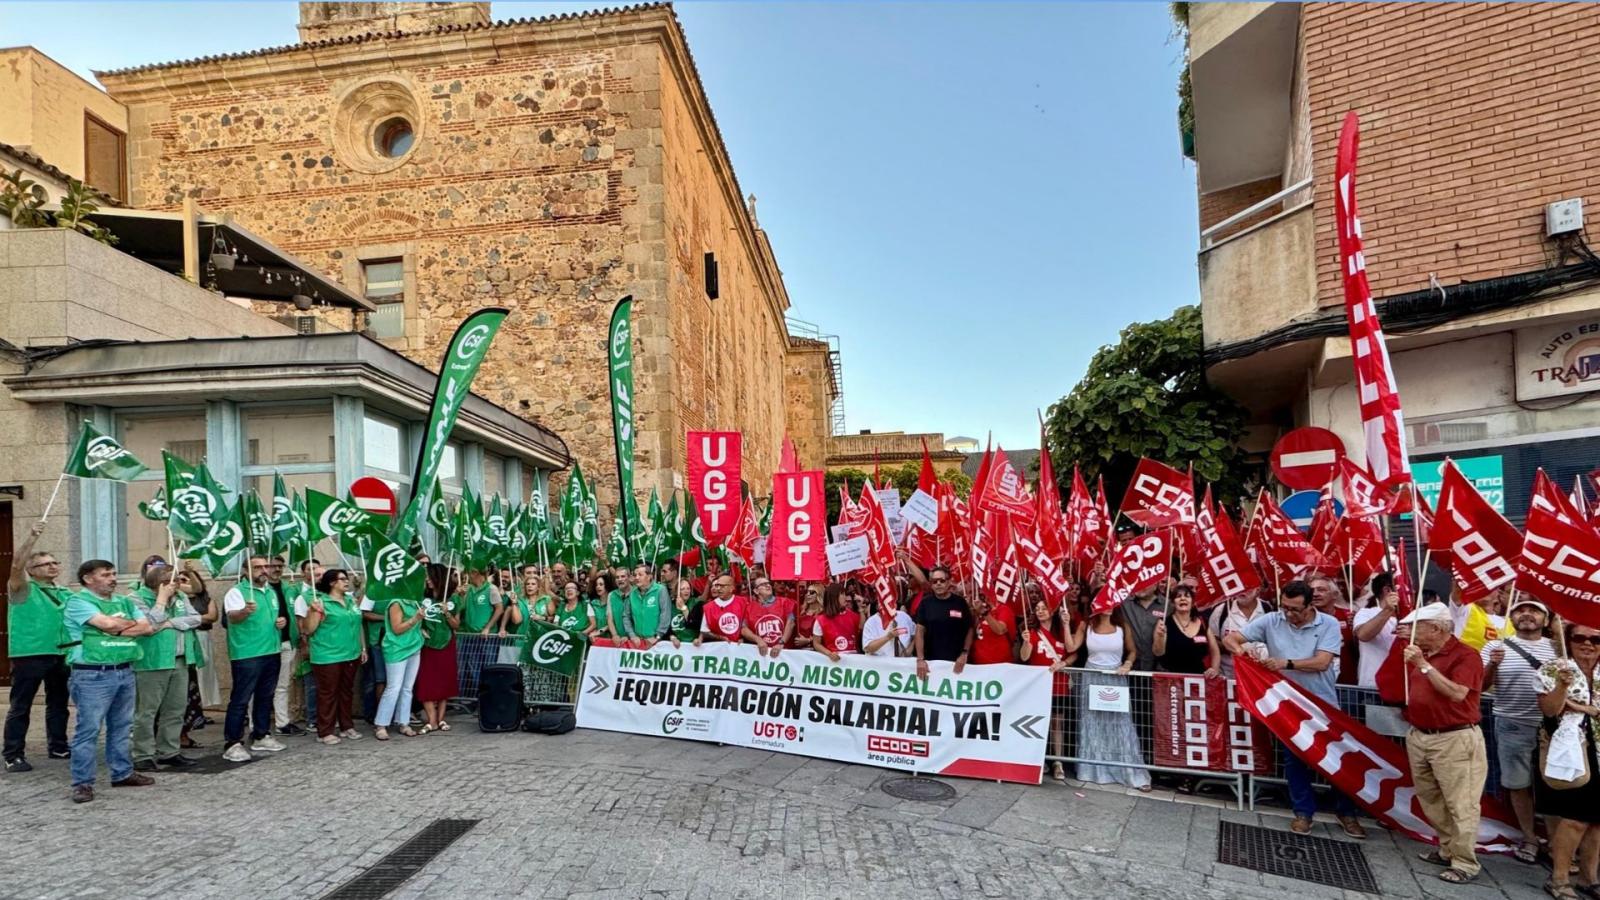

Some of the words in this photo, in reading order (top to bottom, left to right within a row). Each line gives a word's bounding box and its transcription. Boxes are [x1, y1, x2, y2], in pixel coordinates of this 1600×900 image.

[1541, 331, 1573, 359] AUTO
[702, 436, 727, 532] UGT
[786, 476, 811, 576] UGT
[1521, 529, 1600, 584] CC
[721, 615, 737, 626] UGT
[758, 619, 781, 636] UGT
[541, 638, 573, 658] CSIF
[619, 651, 684, 672] MISMO
[692, 655, 794, 685] TRABAJO,
[801, 664, 880, 690] MISMO
[887, 671, 1003, 701] SALARIO
[613, 677, 803, 720] ¡EQUIPARACIÓN
[808, 695, 942, 737] SALARIAL
[952, 711, 1002, 741] YA!
[666, 716, 684, 726] CSIF
[1170, 685, 1180, 756] extremadura
[754, 721, 785, 740] UGT
[1184, 677, 1209, 767] CCOO
[752, 738, 785, 749] Extremadura
[869, 737, 911, 753] CCOO
[867, 752, 885, 762] área
[887, 754, 916, 766] pública
